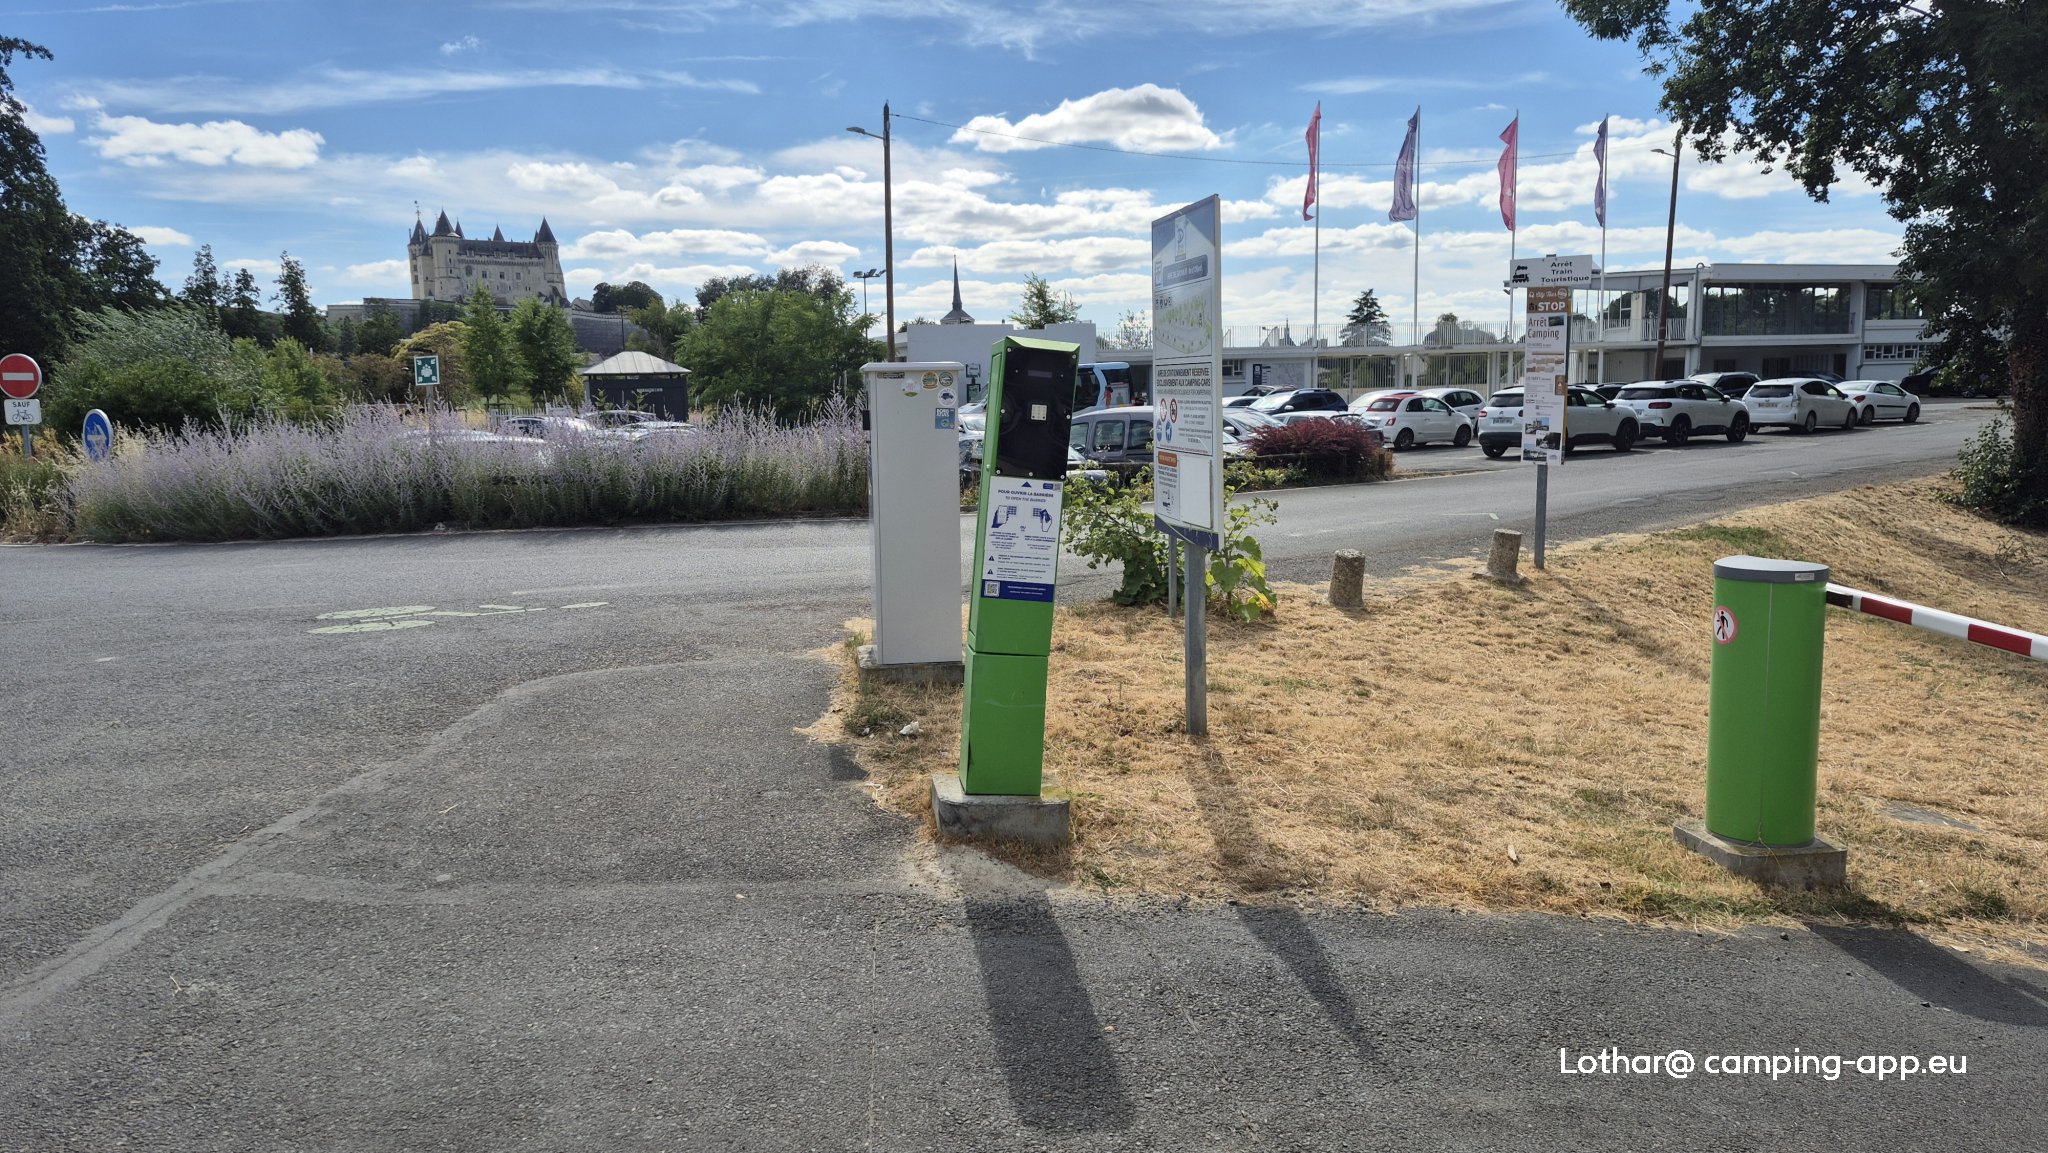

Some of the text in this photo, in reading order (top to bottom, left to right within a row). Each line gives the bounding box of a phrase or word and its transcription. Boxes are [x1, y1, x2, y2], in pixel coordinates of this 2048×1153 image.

[1541, 275, 1590, 283] Touristique
[1538, 302, 1566, 311] STOP
[1528, 317, 1547, 327] Arrêt
[1527, 328, 1560, 340] Camping
[1184, 378, 1211, 387] CAMPING-CARS
